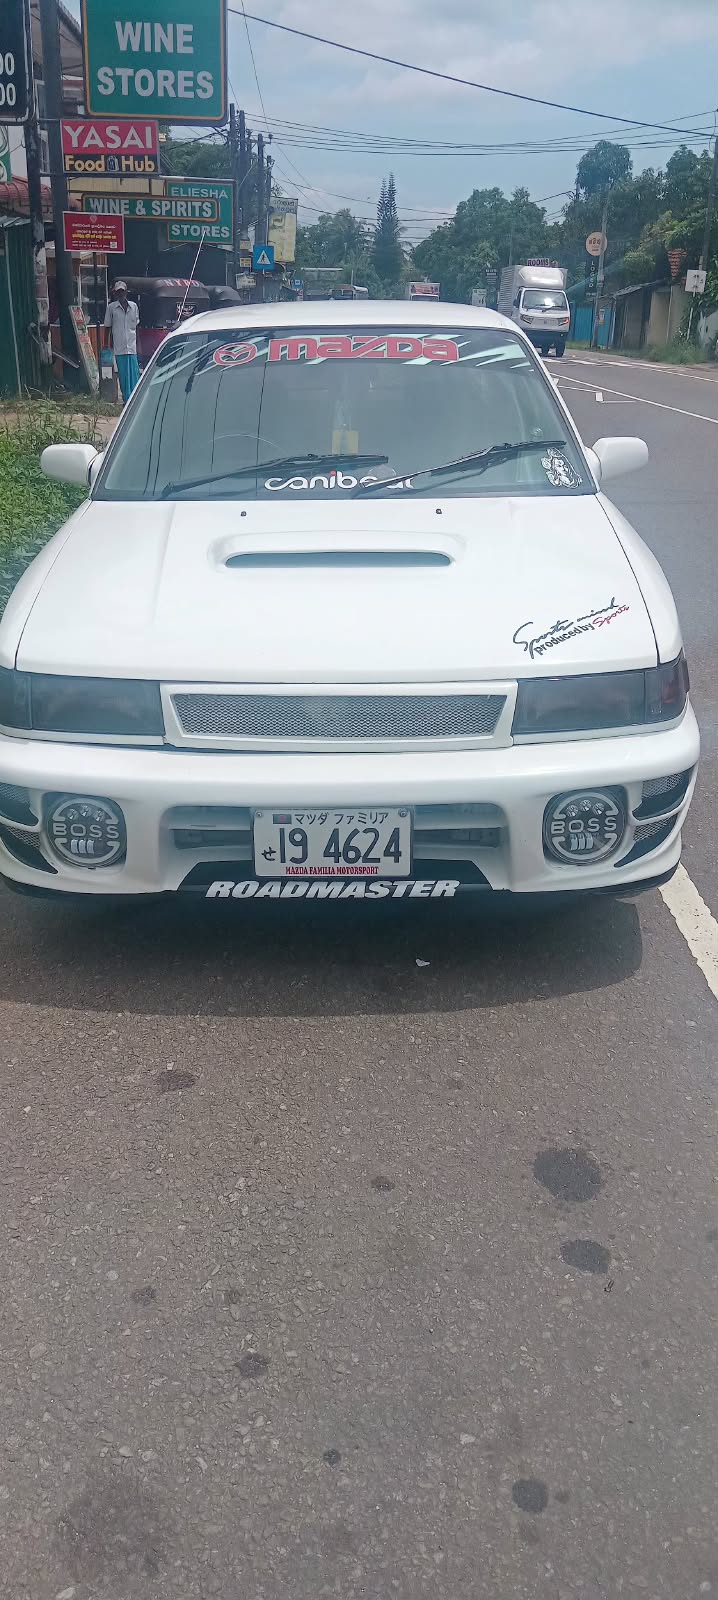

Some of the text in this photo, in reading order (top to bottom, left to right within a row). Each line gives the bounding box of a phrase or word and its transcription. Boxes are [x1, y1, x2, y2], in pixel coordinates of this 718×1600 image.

[115, 21, 194, 54] WINE
[97, 66, 214, 99] STORES
[64, 125, 153, 149] YASAI
[65, 155, 155, 172] Food Hub
[171, 187, 228, 199] ELIESHA
[89, 198, 212, 218] WINE & SPIRITS
[171, 224, 230, 238] STORES
[294, 811, 389, 826] マツダ ファミリア
[551, 816, 617, 834] BOSS
[52, 823, 119, 838] BOSS
[279, 827, 309, 864] 19
[323, 827, 402, 864] 4624
[286, 866, 380, 875] MAZDA FAMILIA MOTORSPORT
[205, 879, 461, 899] ROADMASTER
